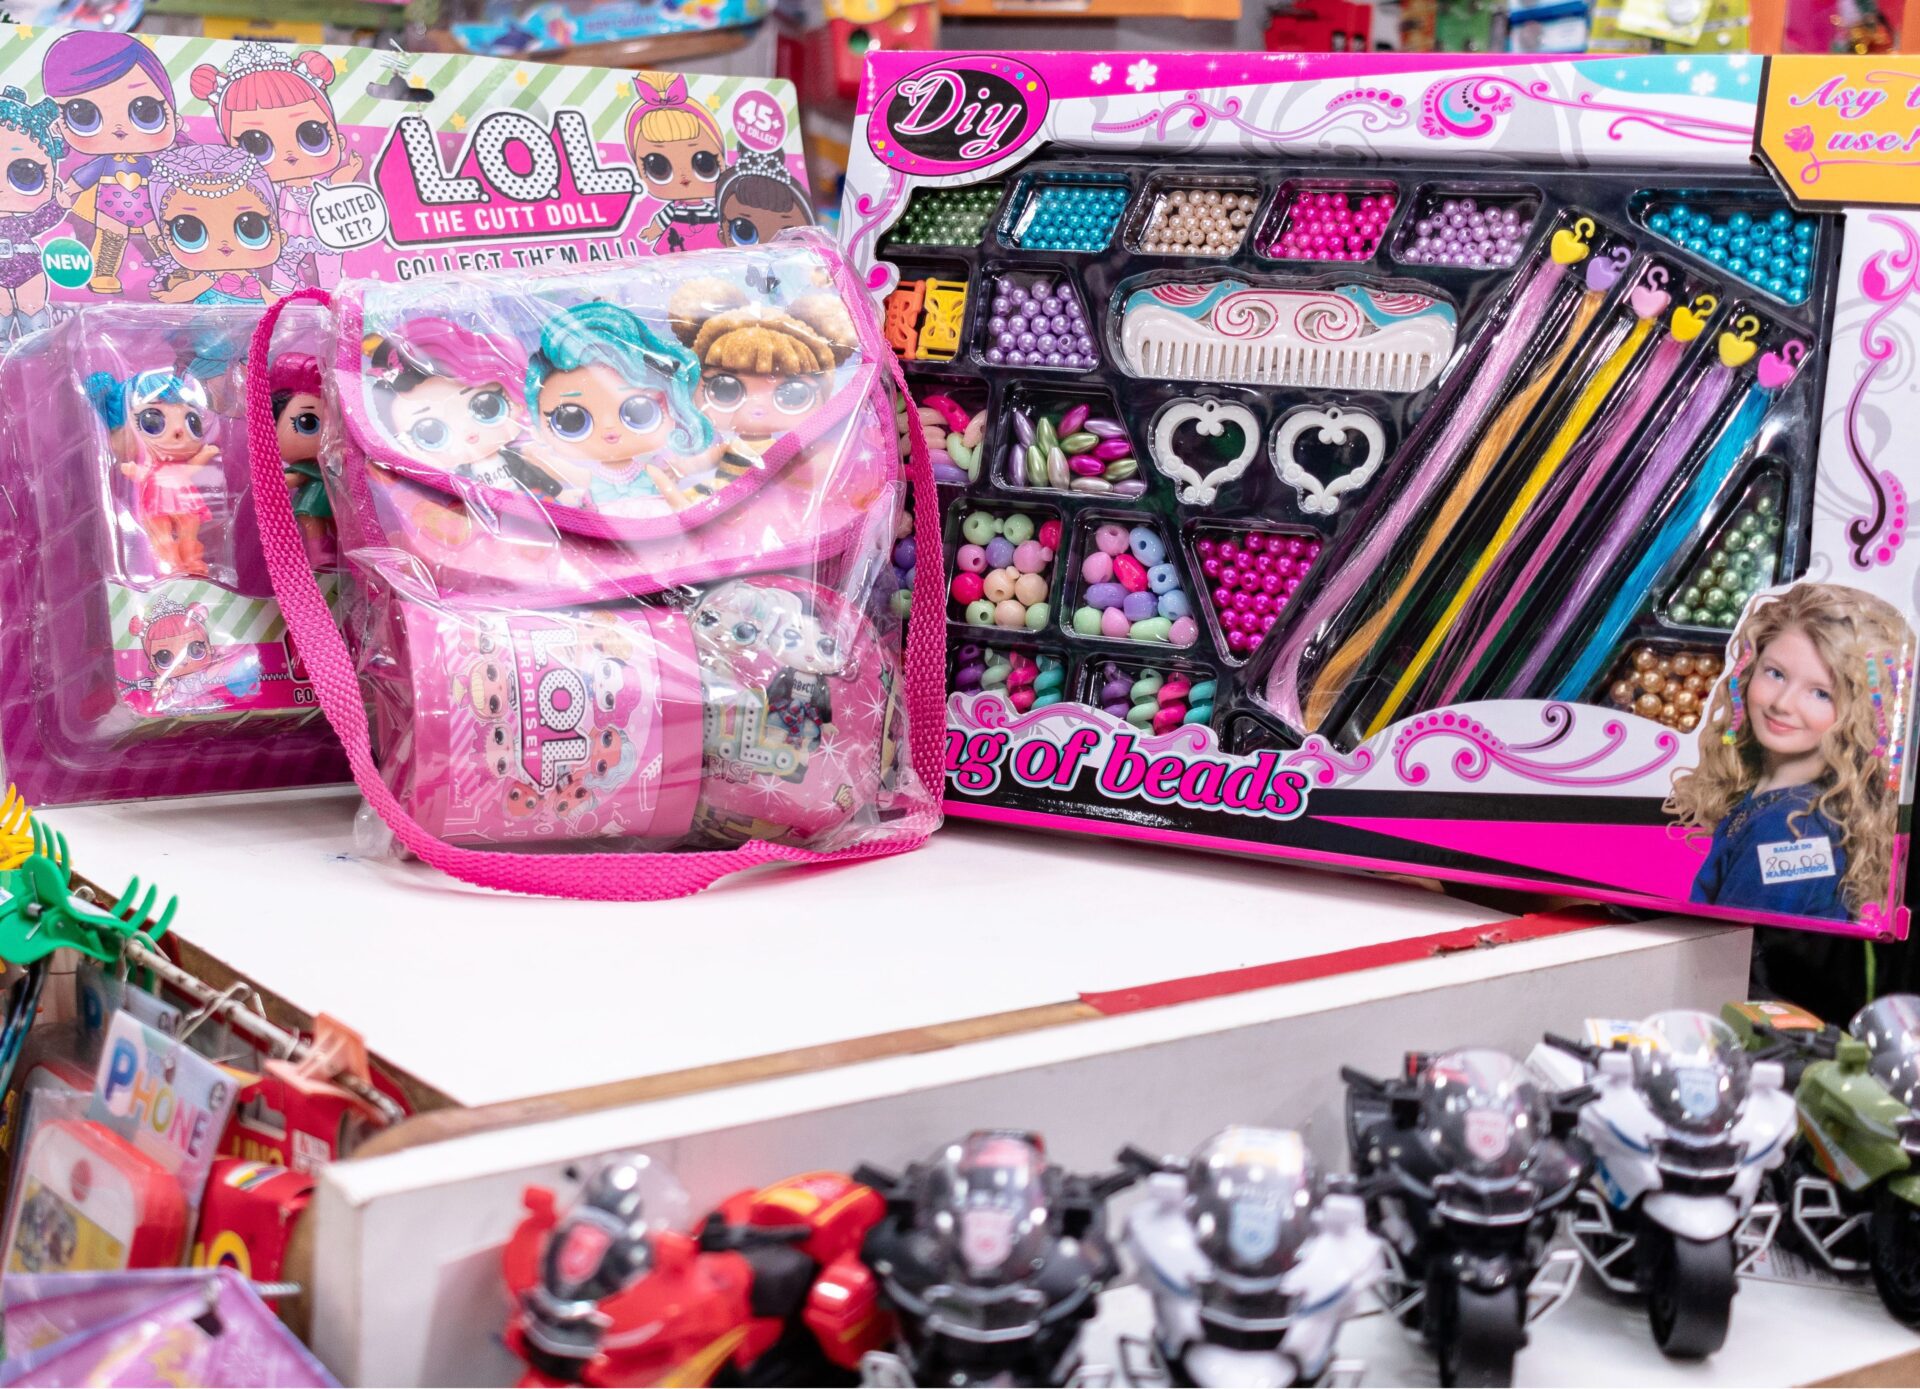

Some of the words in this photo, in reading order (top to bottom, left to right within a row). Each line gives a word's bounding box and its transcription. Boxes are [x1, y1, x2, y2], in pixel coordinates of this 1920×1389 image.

[1790, 75, 1887, 119] Asy
[738, 100, 781, 132] 45+
[894, 69, 1022, 159] Diy
[736, 121, 746, 133] TO
[746, 125, 778, 147] COLLECT
[1827, 127, 1920, 151] use!
[316, 193, 376, 225] EXCITED
[416, 210, 467, 235] THE
[474, 206, 536, 232] CUTT
[546, 202, 608, 226] DOLL
[336, 217, 373, 242] YET?
[45, 253, 90, 270] NEW
[946, 729, 1007, 789] ng
[1014, 729, 1099, 786] of
[1101, 733, 1308, 815] beads
[1774, 844, 1799, 853] BAZAR
[106, 1037, 208, 1158] PHONE
